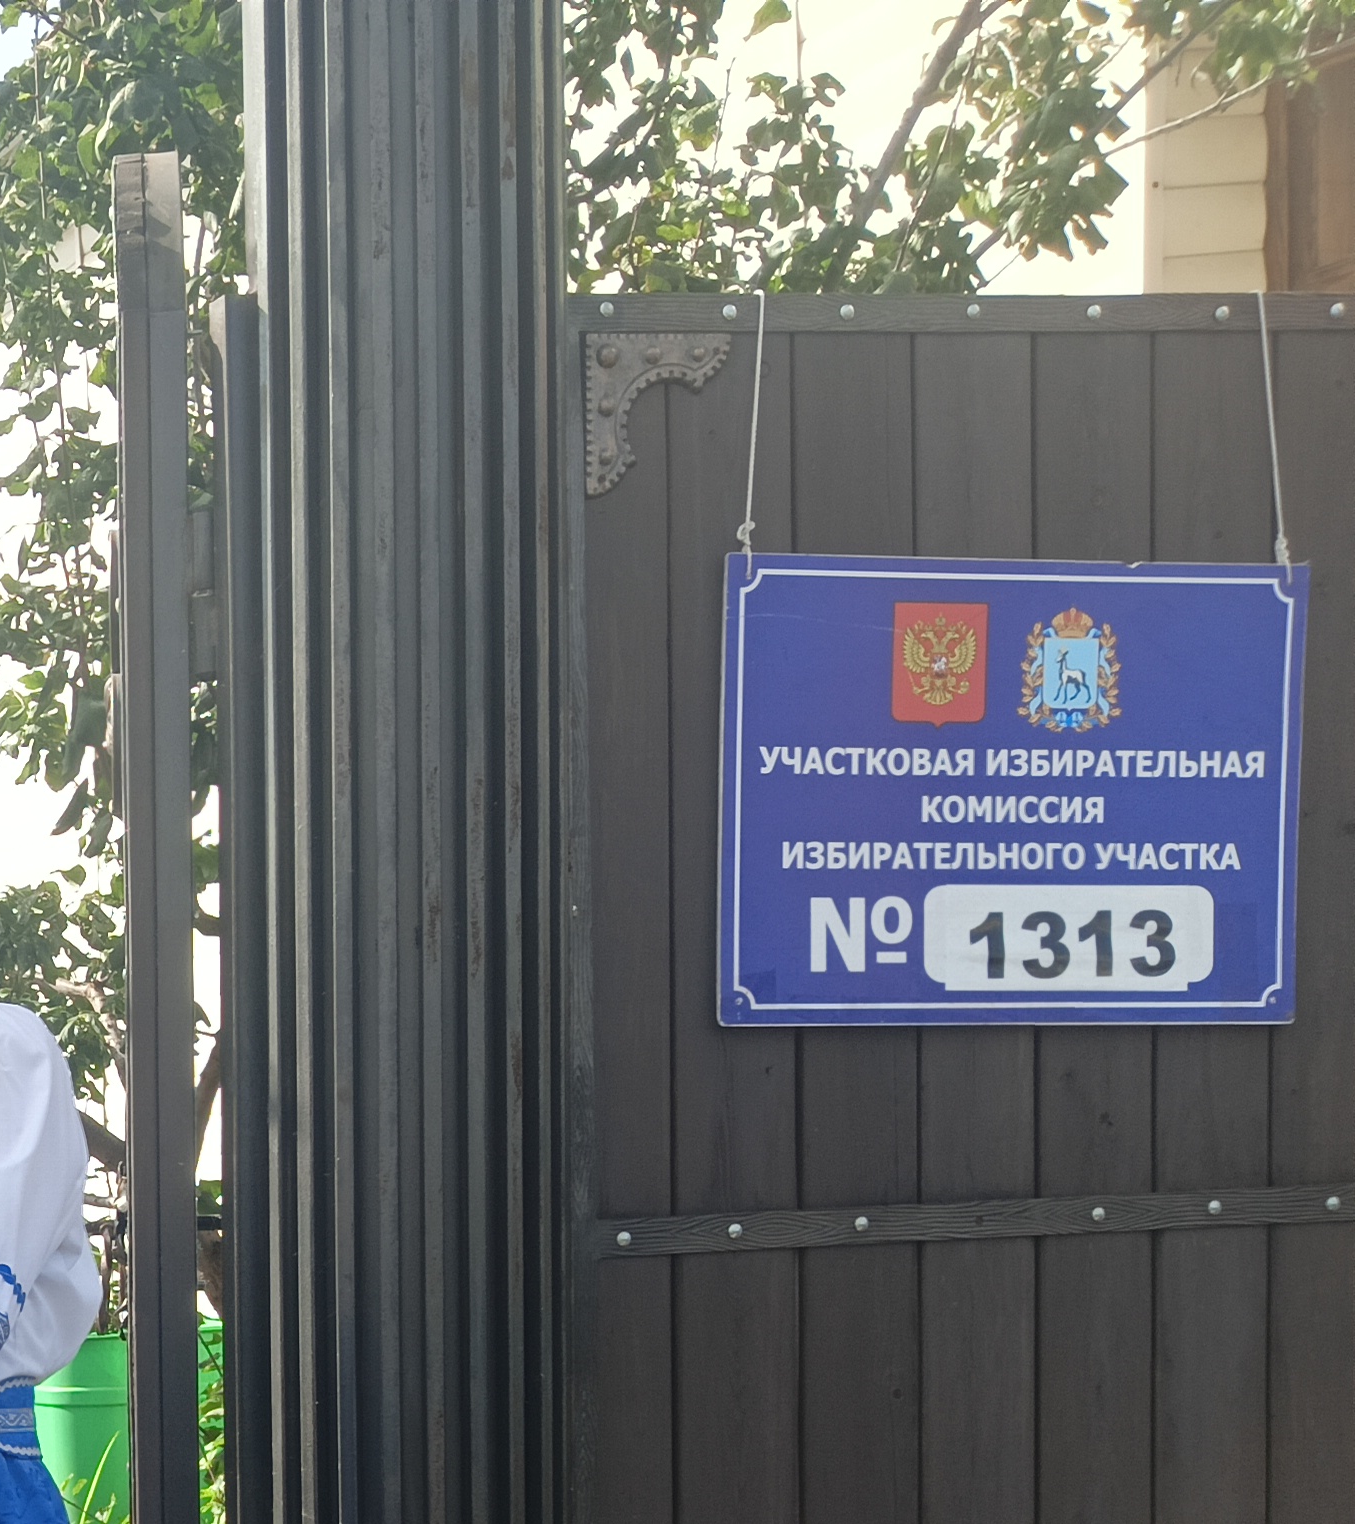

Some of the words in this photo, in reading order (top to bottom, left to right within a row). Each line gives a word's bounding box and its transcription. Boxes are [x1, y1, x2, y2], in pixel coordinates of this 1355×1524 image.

[759, 746, 975, 776] УЧАСТКОВАЯ
[986, 748, 1265, 778] ИЗБИРАТЕЛЬНАЯ
[921, 795, 1105, 824] КОМИССИЯ
[782, 841, 1085, 870] ИЗБИРАТЕЛЬНОГО
[1095, 842, 1241, 871] УЧАСТКА
[809, 895, 914, 973] №
[969, 909, 1177, 979] 1313
